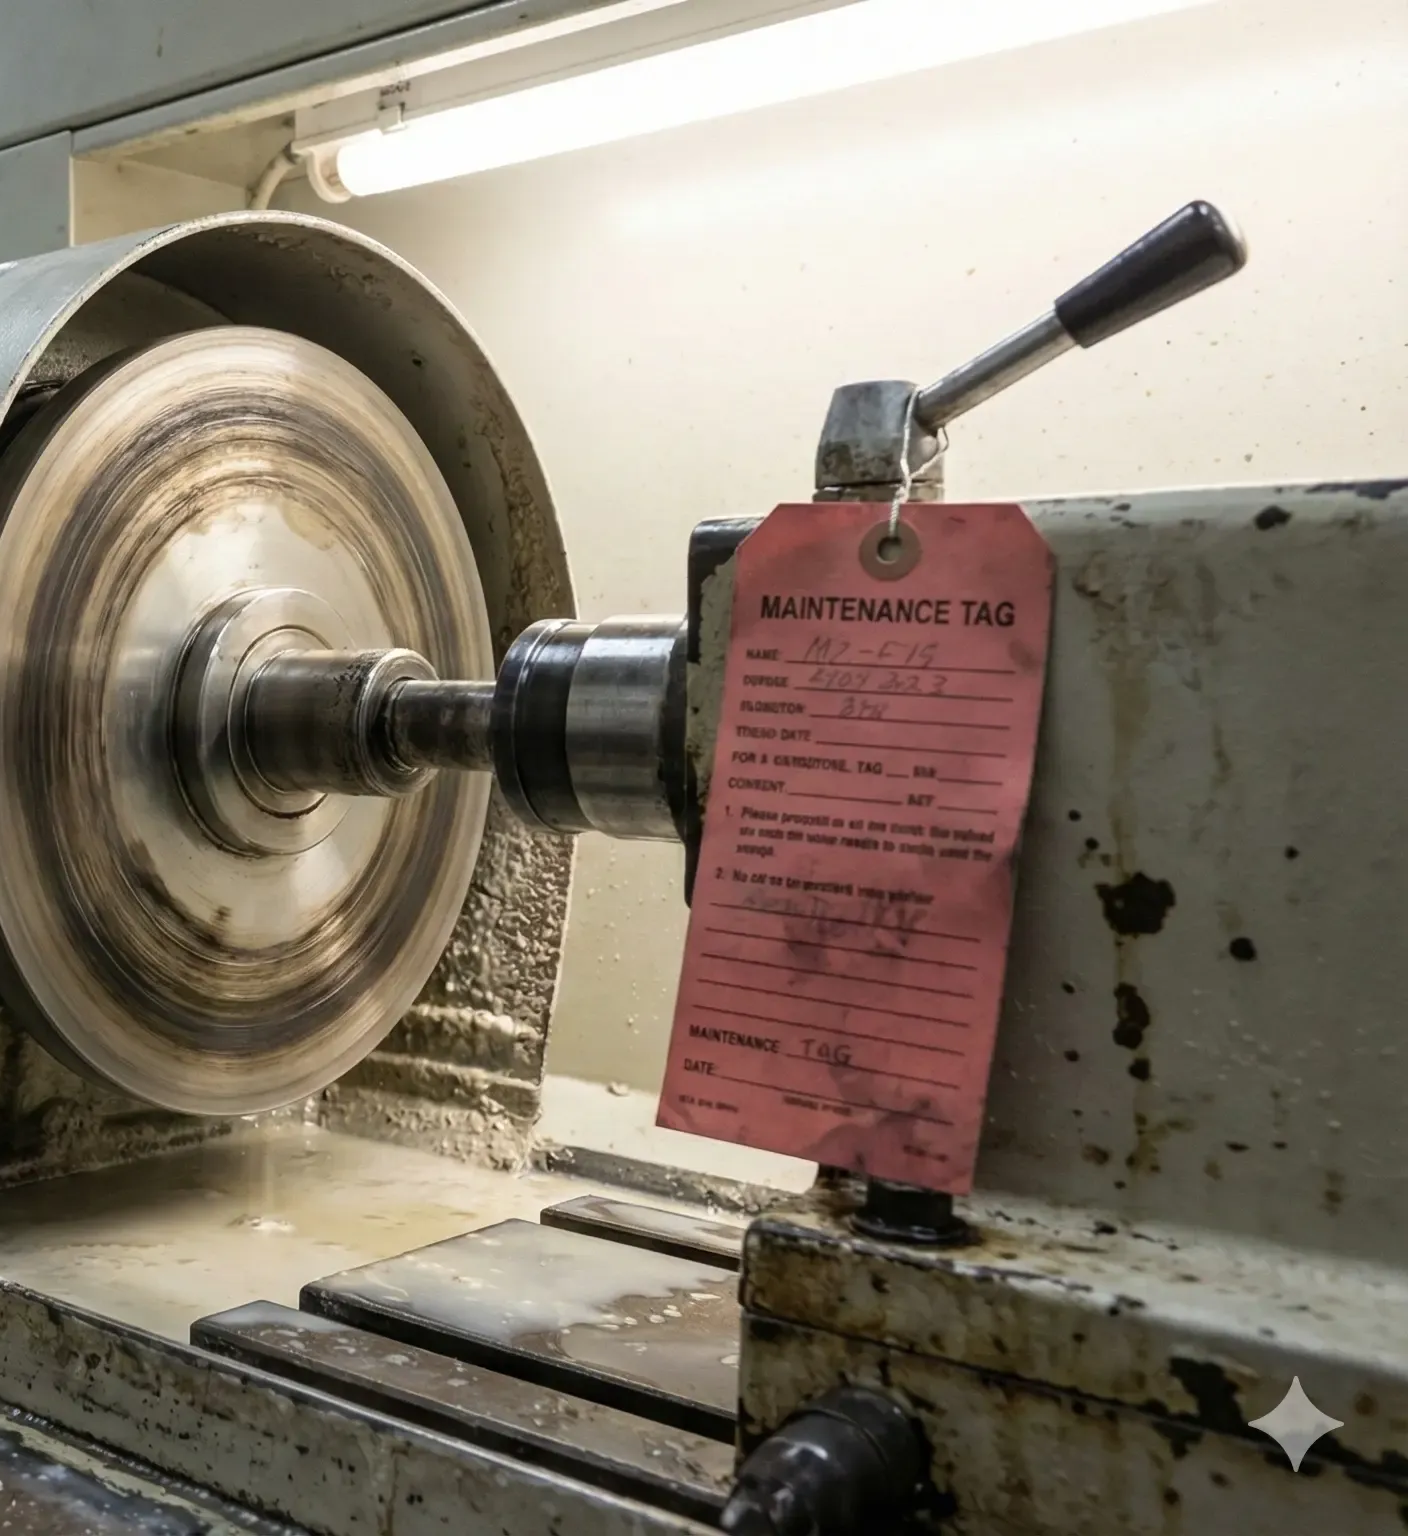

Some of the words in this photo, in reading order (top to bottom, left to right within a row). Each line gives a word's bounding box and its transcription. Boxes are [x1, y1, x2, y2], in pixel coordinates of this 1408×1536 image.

[760, 594, 950, 625] MAINTENANCE
[960, 600, 1016, 627] TAG
[731, 751, 757, 764] FOR
[856, 761, 884, 775] TAG
[688, 1023, 781, 1053] MAINTENANCE
